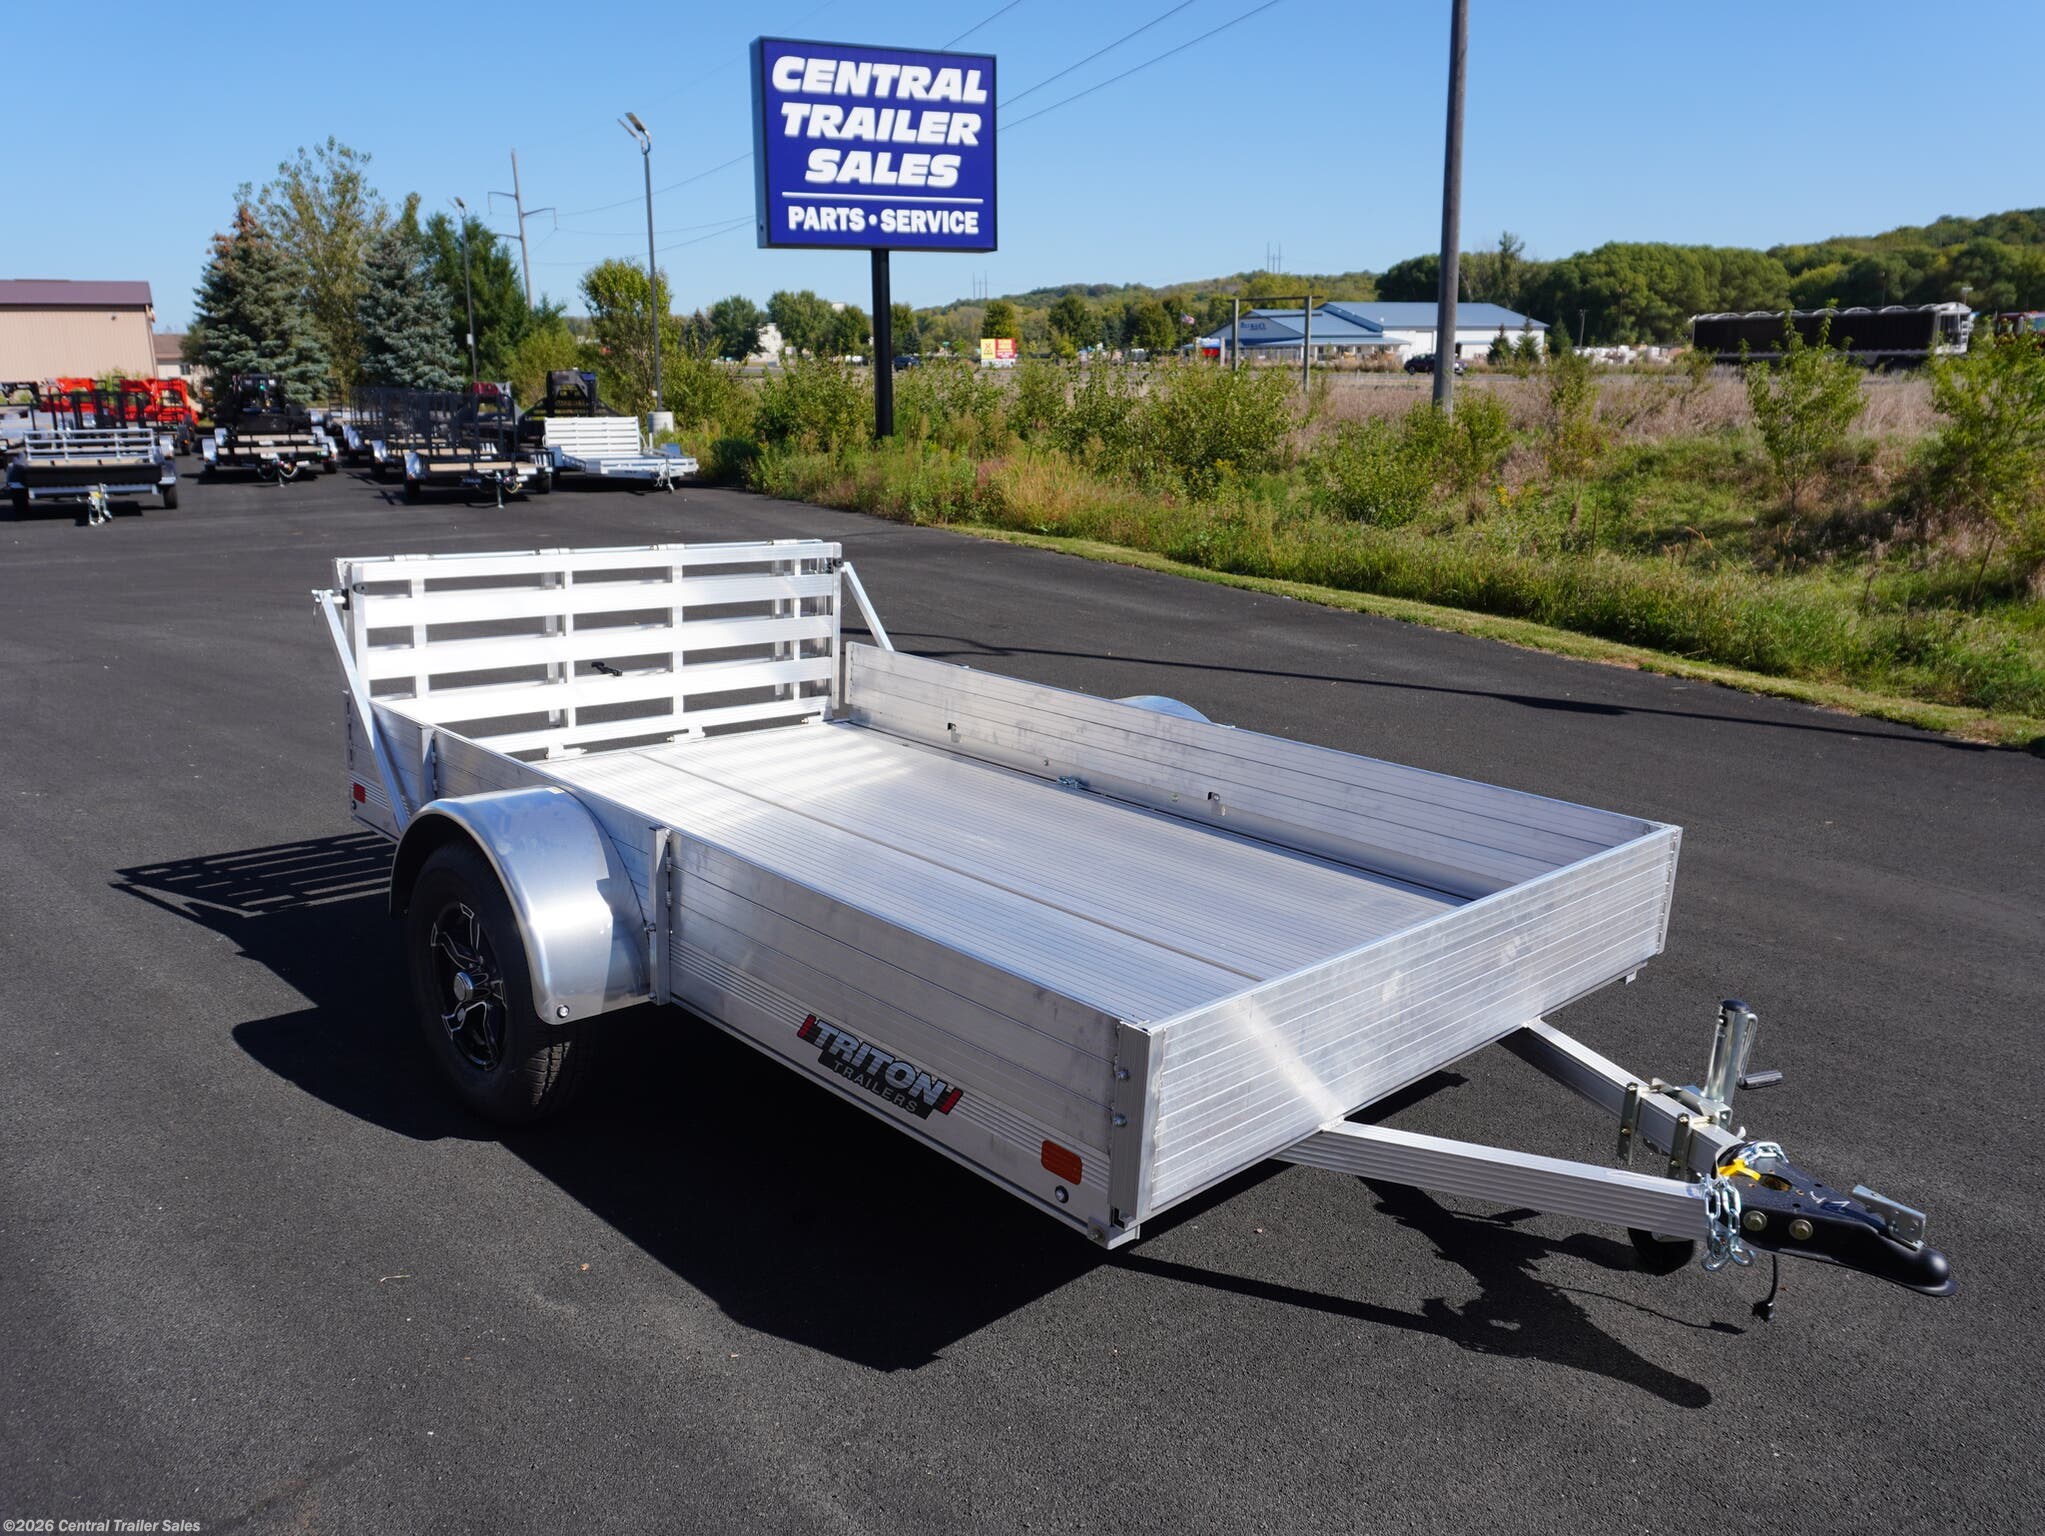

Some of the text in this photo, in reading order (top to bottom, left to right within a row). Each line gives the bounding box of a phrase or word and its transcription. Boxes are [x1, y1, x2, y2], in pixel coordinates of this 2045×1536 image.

[771, 55, 987, 104] CENTRAL
[780, 102, 982, 146] TRAILER
[804, 148, 961, 188] SALES
[813, 1020, 946, 1106] TRITON
[832, 1061, 918, 1113] TRAILERS
